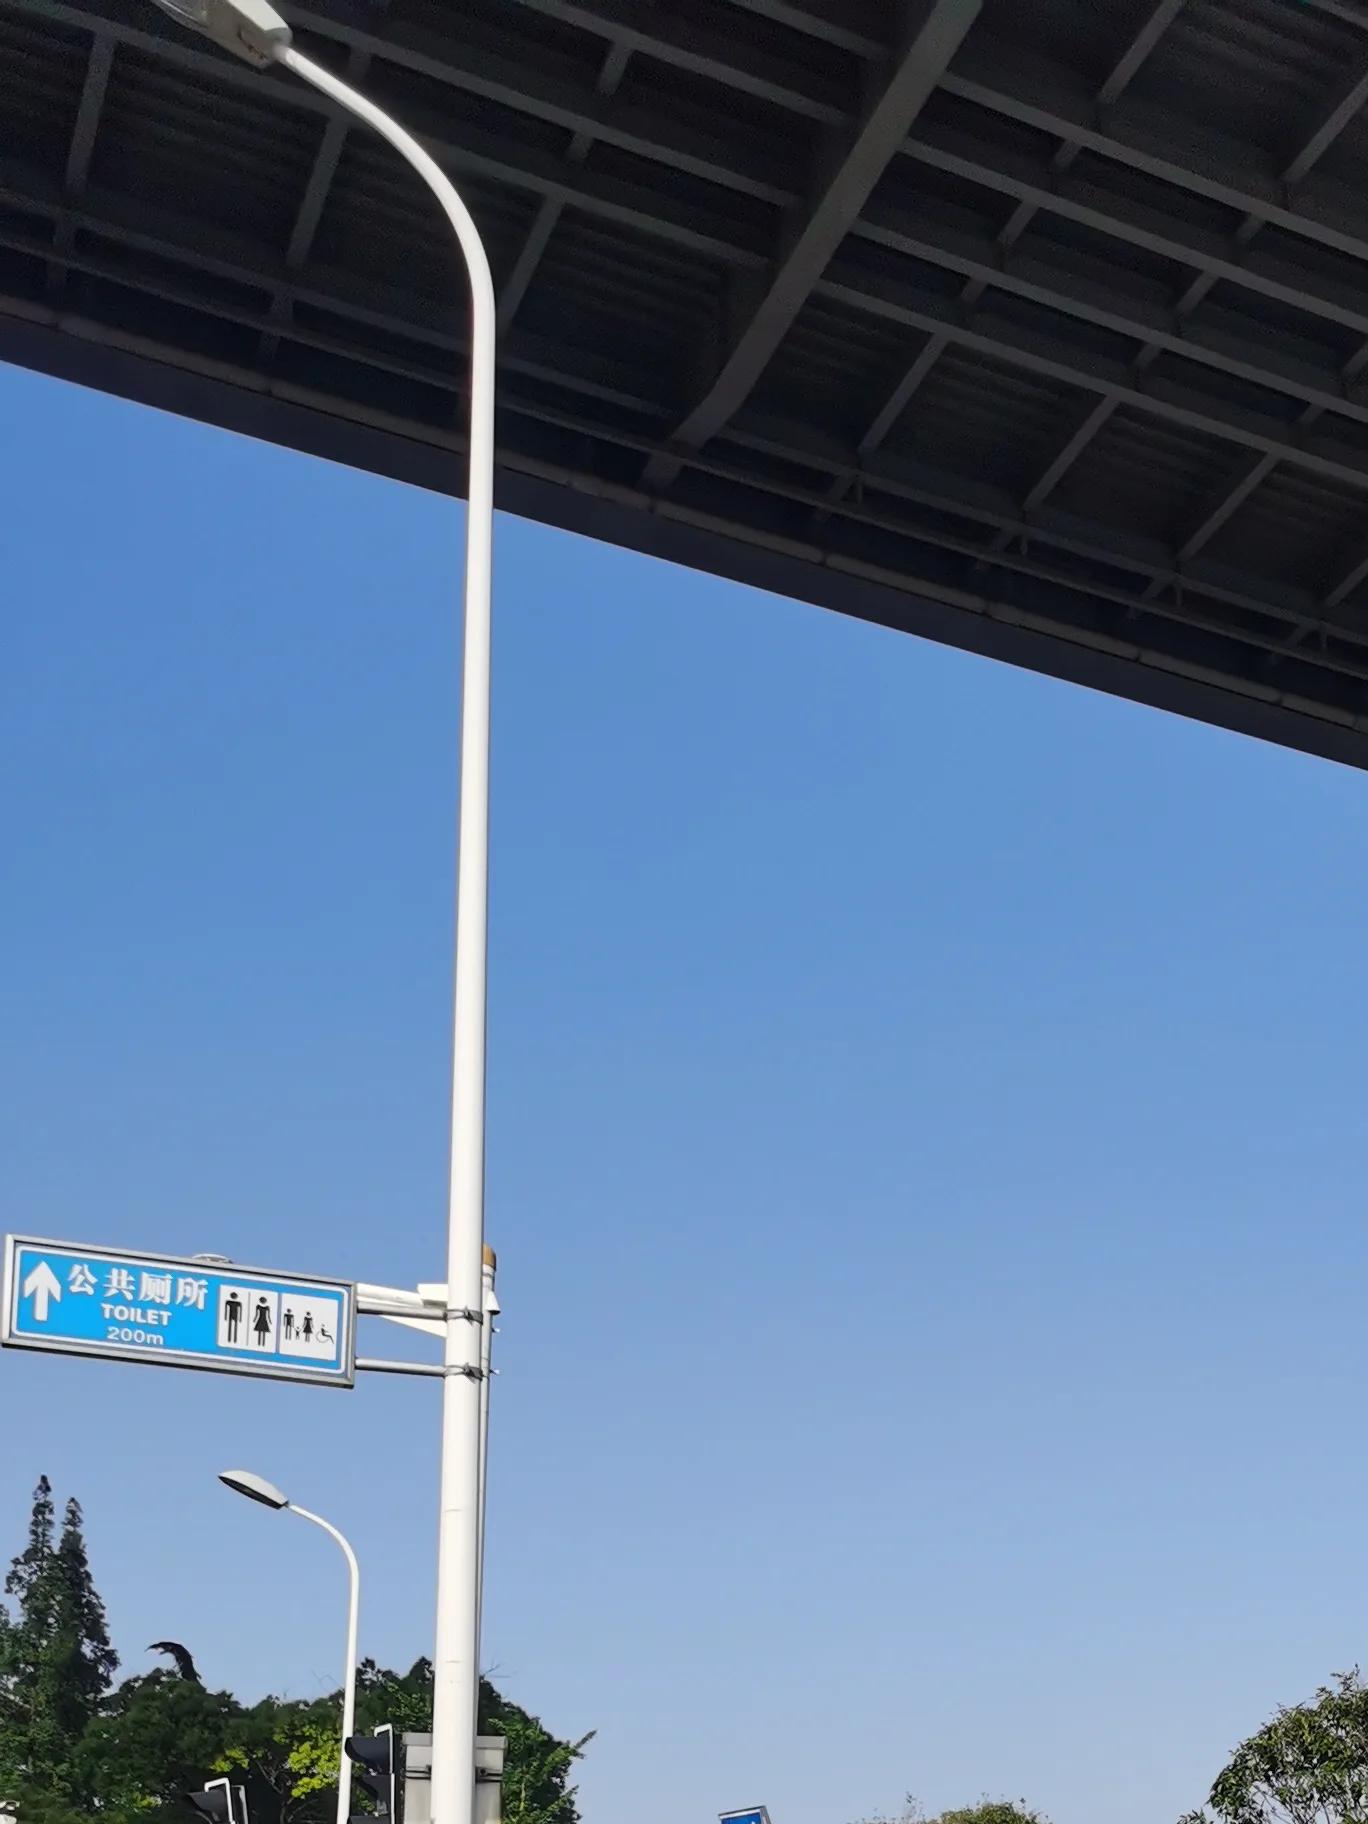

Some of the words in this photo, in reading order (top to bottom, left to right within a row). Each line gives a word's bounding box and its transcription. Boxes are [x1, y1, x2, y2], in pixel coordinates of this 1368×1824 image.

[67, 1263, 208, 1311] 公共厕所
[101, 1302, 172, 1326] TOILET
[106, 1326, 164, 1345] 200m
